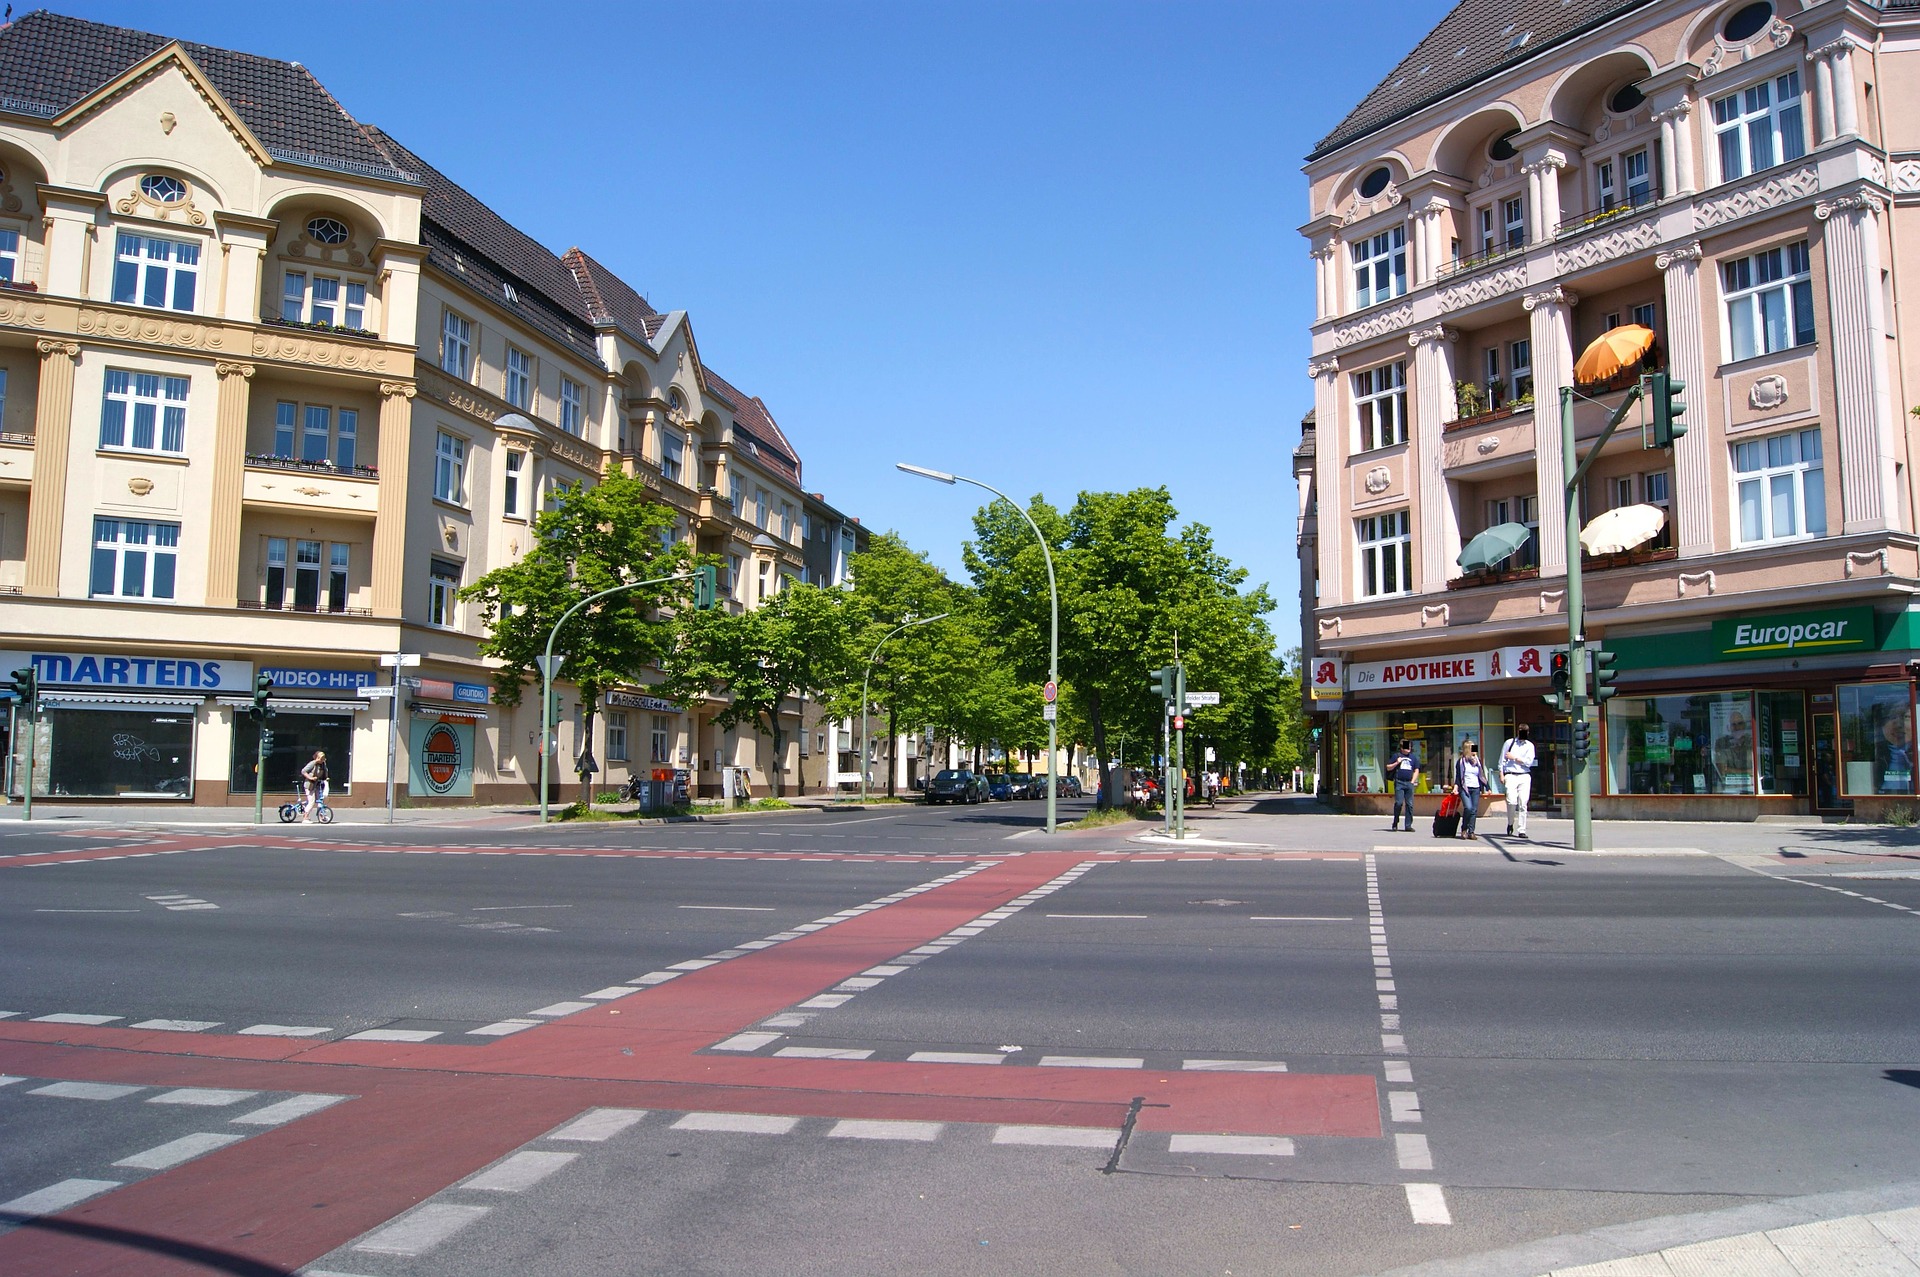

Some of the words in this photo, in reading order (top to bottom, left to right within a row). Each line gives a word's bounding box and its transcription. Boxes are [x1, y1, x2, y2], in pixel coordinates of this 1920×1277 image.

[1735, 620, 1848, 648] Europcar
[32, 654, 221, 688] MARTENS
[267, 670, 321, 686] VIDEO
[329, 672, 369, 687] HI-FI
[1358, 671, 1376, 683] Die
[1382, 659, 1475, 683] APOTHEKE
[458, 687, 484, 698] GRUNDIG
[1761, 704, 1772, 779] Europcar
[427, 753, 457, 763] MARTENS
